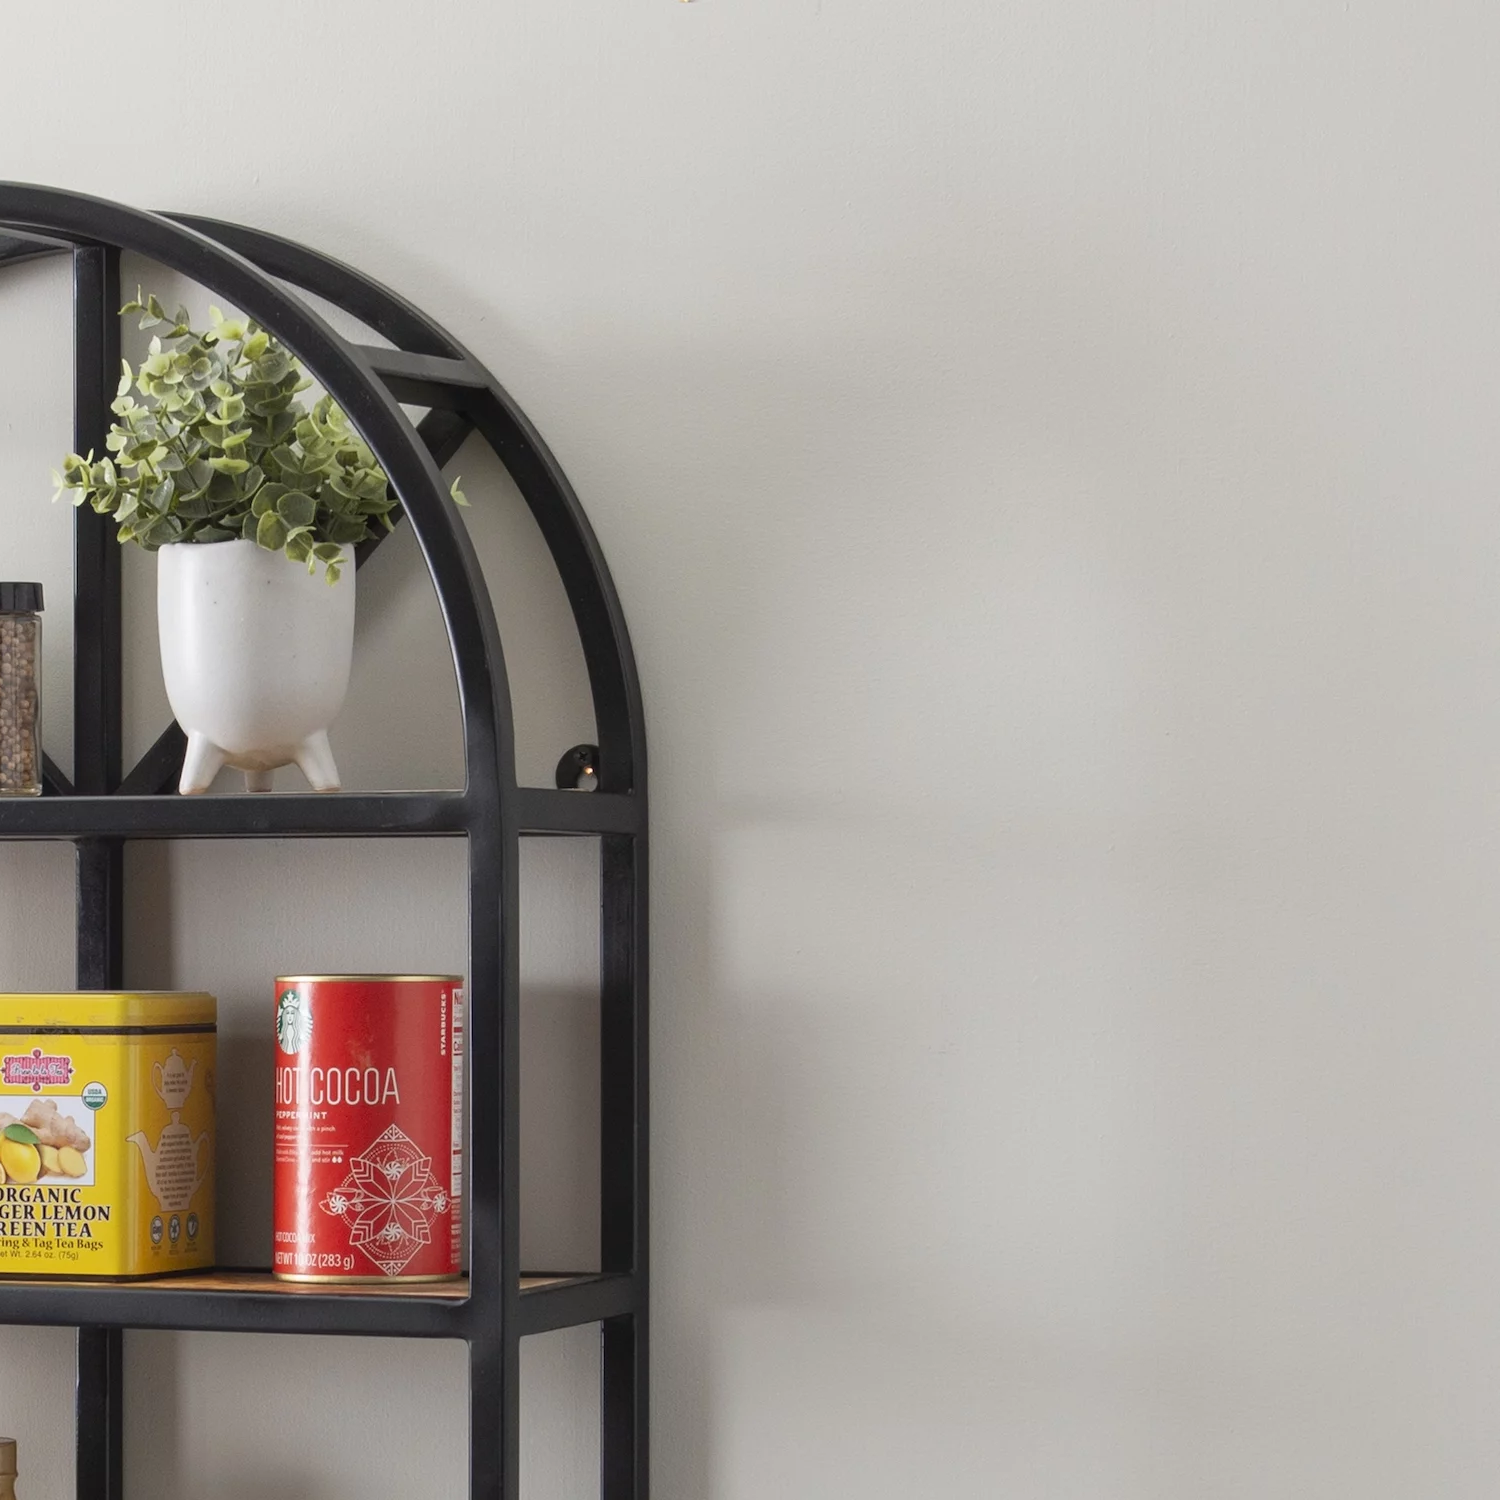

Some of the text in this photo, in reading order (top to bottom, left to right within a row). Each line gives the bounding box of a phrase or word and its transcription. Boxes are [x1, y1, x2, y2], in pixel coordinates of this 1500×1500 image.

[276, 1067, 400, 1105] HOT COCOA
[41, 1204, 111, 1221] LEMON
[52, 1222, 92, 1238] TEA
[21, 1238, 31, 1247] &
[33, 1238, 53, 1250] Tag
[55, 1239, 74, 1249] Tea
[76, 1239, 104, 1251] Bags
[25, 1250, 42, 1258] 2.64
[58, 1251, 79, 1260] (75g)
[318, 1253, 341, 1268] (283
[343, 1254, 355, 1271] g)
